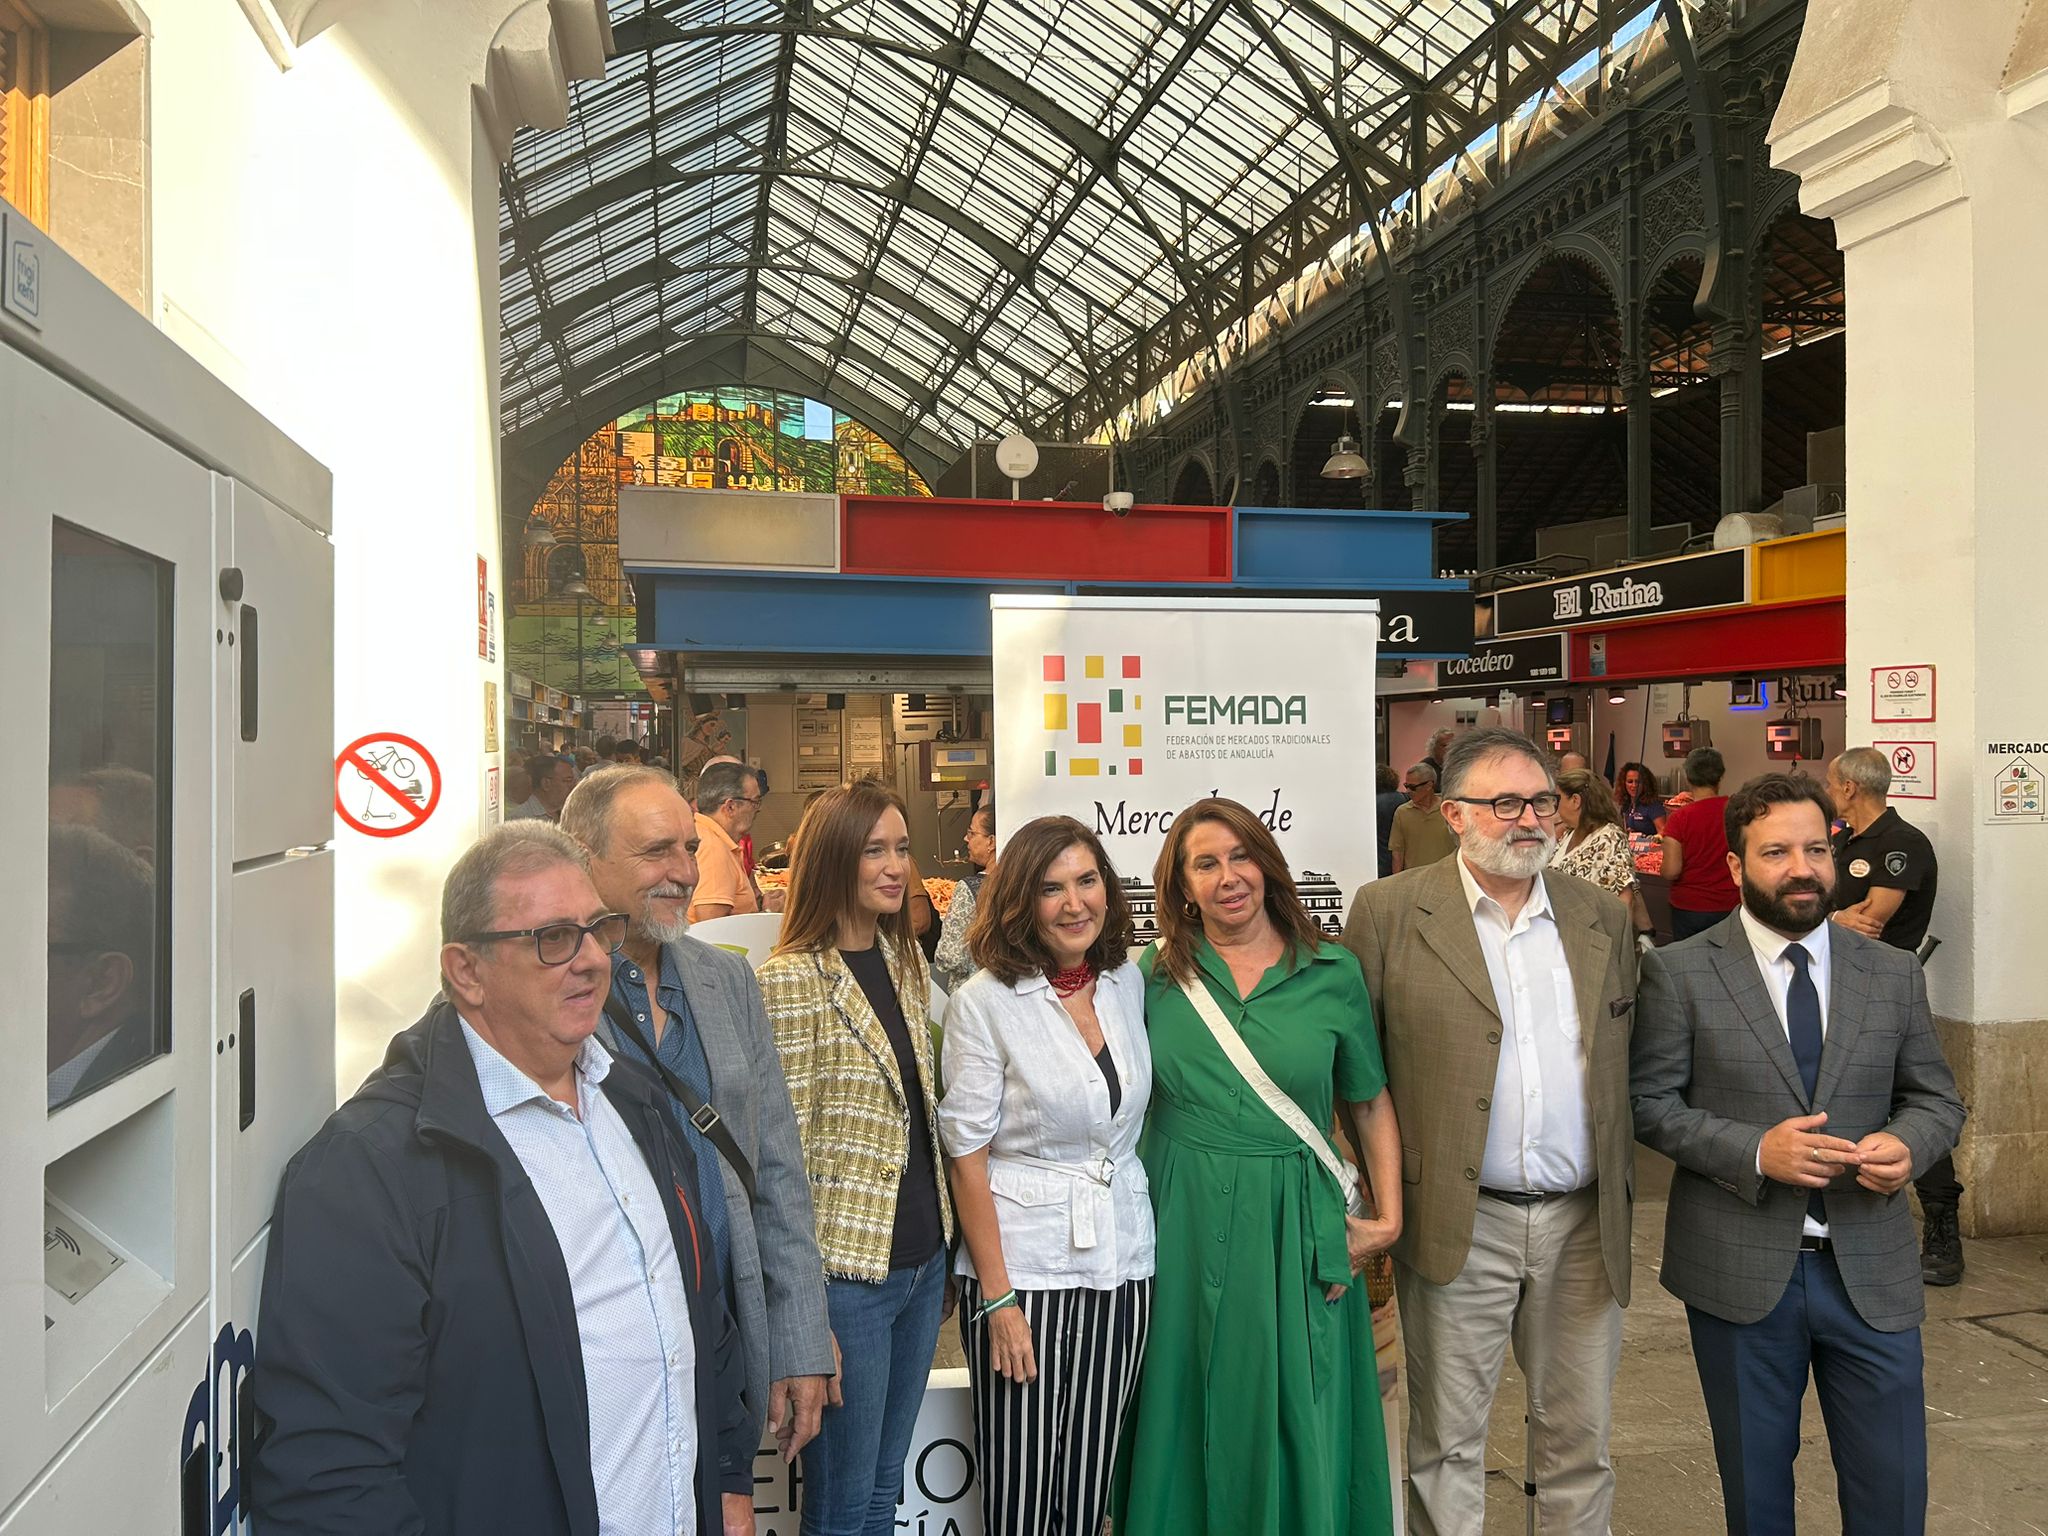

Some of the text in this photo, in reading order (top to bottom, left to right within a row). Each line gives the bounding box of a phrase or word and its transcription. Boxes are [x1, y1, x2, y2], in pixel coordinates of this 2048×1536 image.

[1553, 577, 1664, 620] El Ruina
[1446, 649, 1514, 675] Cocedero
[1165, 695, 1307, 725] FEMADA
[1166, 733, 1331, 745] FEDERACIÓN DE MERCADOS TRADICIONALES
[1166, 747, 1275, 759] DE ABASTOS DE ANDALUCÍA
[1258, 788, 1293, 832] de
